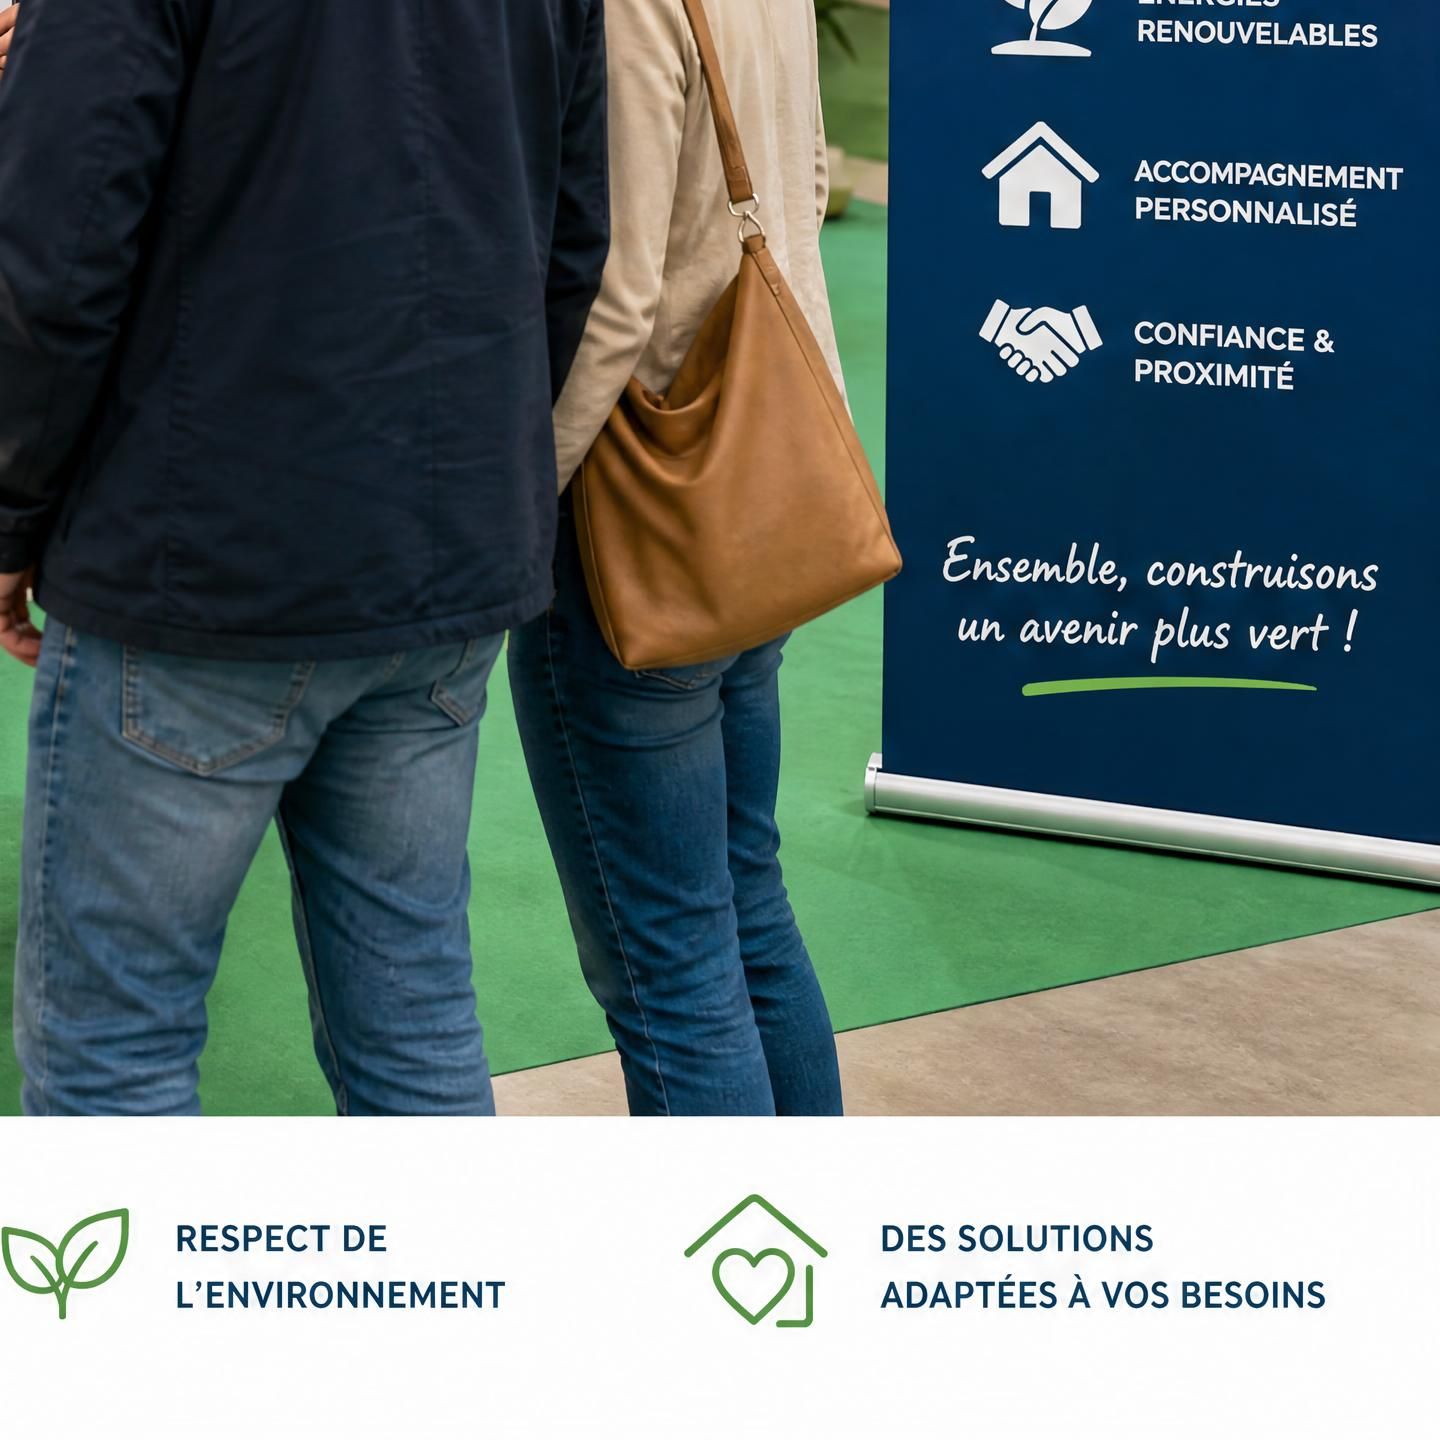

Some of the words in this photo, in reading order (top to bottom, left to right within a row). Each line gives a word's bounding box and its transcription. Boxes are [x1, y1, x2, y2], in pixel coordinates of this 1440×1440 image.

[1138, 20, 1377, 47] RENOUVELABLES
[1134, 160, 1403, 190] ACCOMPAGNEMENT
[1136, 197, 1356, 227] PERSONNALISÉ
[1135, 321, 1304, 351] CONFIANCE
[1314, 329, 1334, 352] &
[1135, 359, 1293, 390] PROXIMITÉ
[943, 536, 1127, 592] Ensemble,
[1147, 550, 1378, 591] construisons
[958, 618, 1005, 641] un
[1020, 611, 1138, 645] avenir
[1151, 606, 1230, 663] plus
[1250, 614, 1329, 651] vert
[1344, 609, 1358, 652] !
